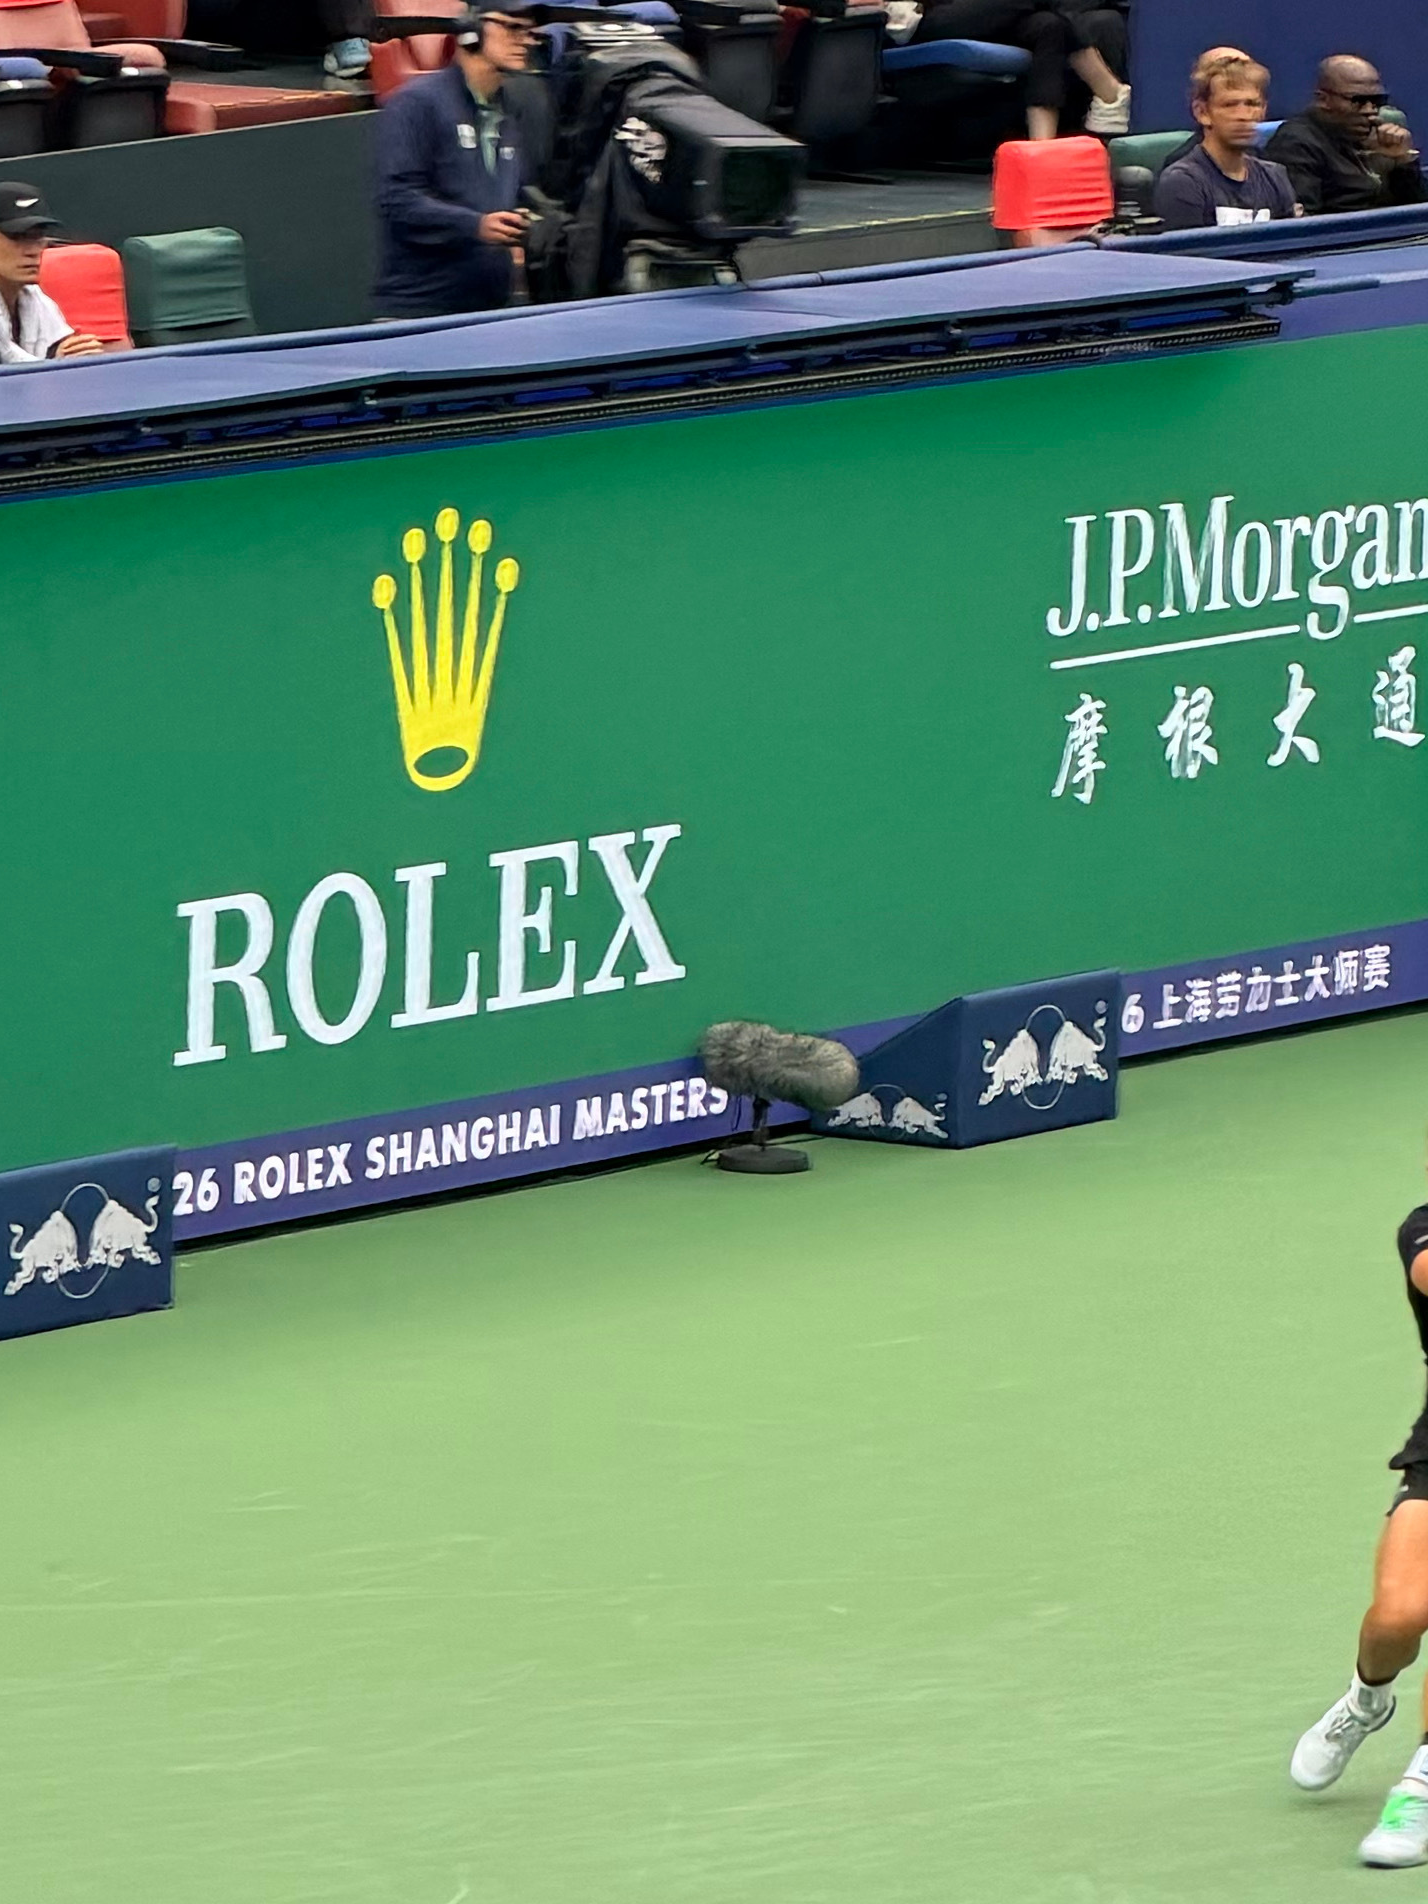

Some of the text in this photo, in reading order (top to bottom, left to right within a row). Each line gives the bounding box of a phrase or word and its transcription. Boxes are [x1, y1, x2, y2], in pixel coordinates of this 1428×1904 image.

[1050, 645, 1426, 804] 摩根大通
[173, 824, 687, 1066] ROLEX
[1152, 944, 1391, 1030] 上海劳力士大师赛
[233, 1142, 353, 1204] ROLEX
[364, 1104, 561, 1180] SHANGHAI
[572, 1077, 729, 1141] MASTERS
